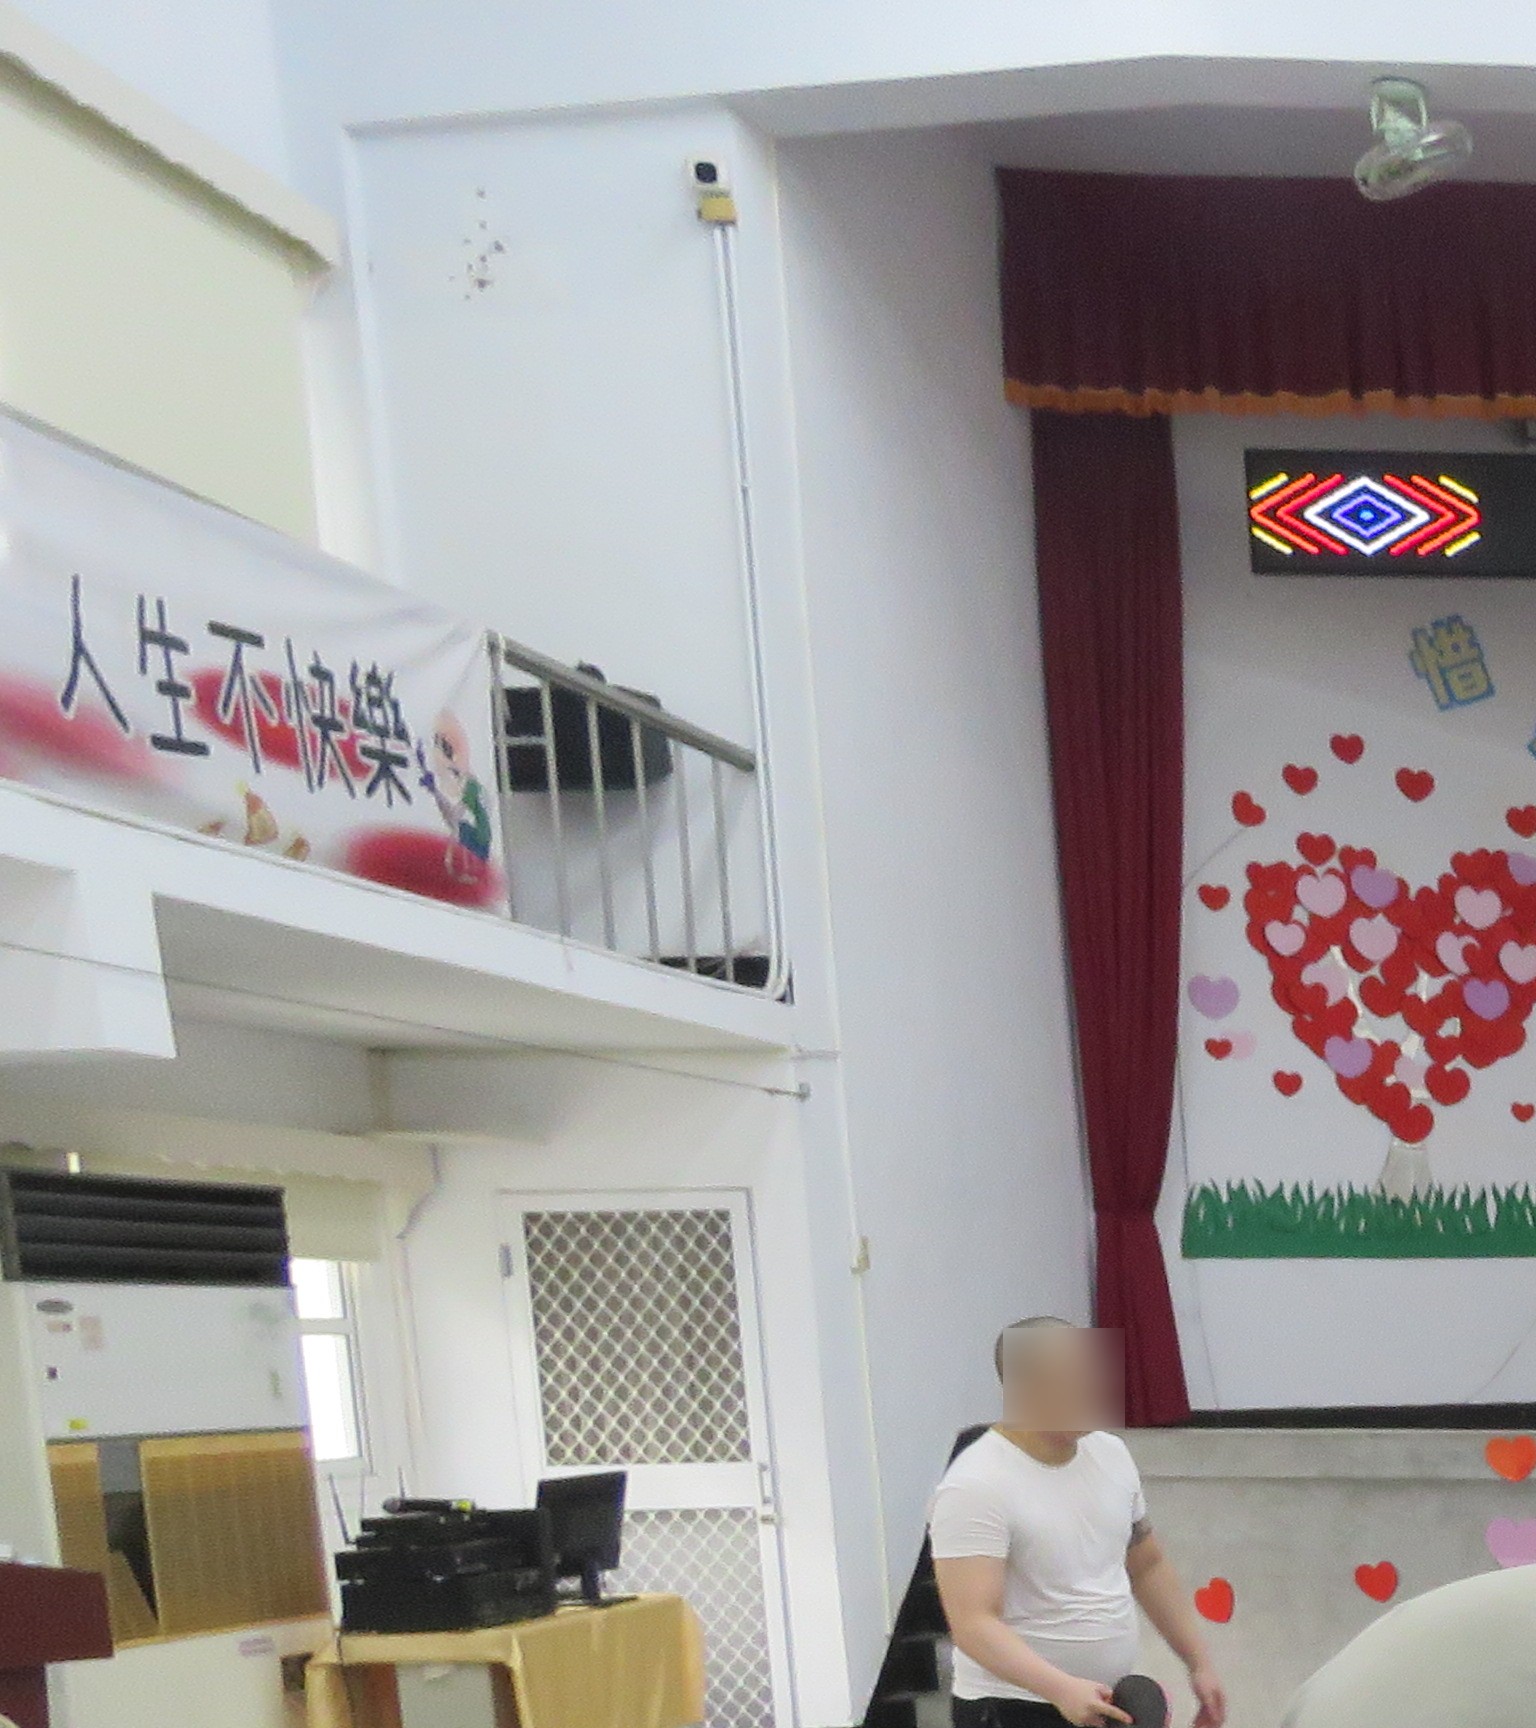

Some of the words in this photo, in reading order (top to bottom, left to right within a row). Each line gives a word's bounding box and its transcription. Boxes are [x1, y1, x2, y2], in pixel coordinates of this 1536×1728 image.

[60, 572, 414, 810] 人生不快樂
